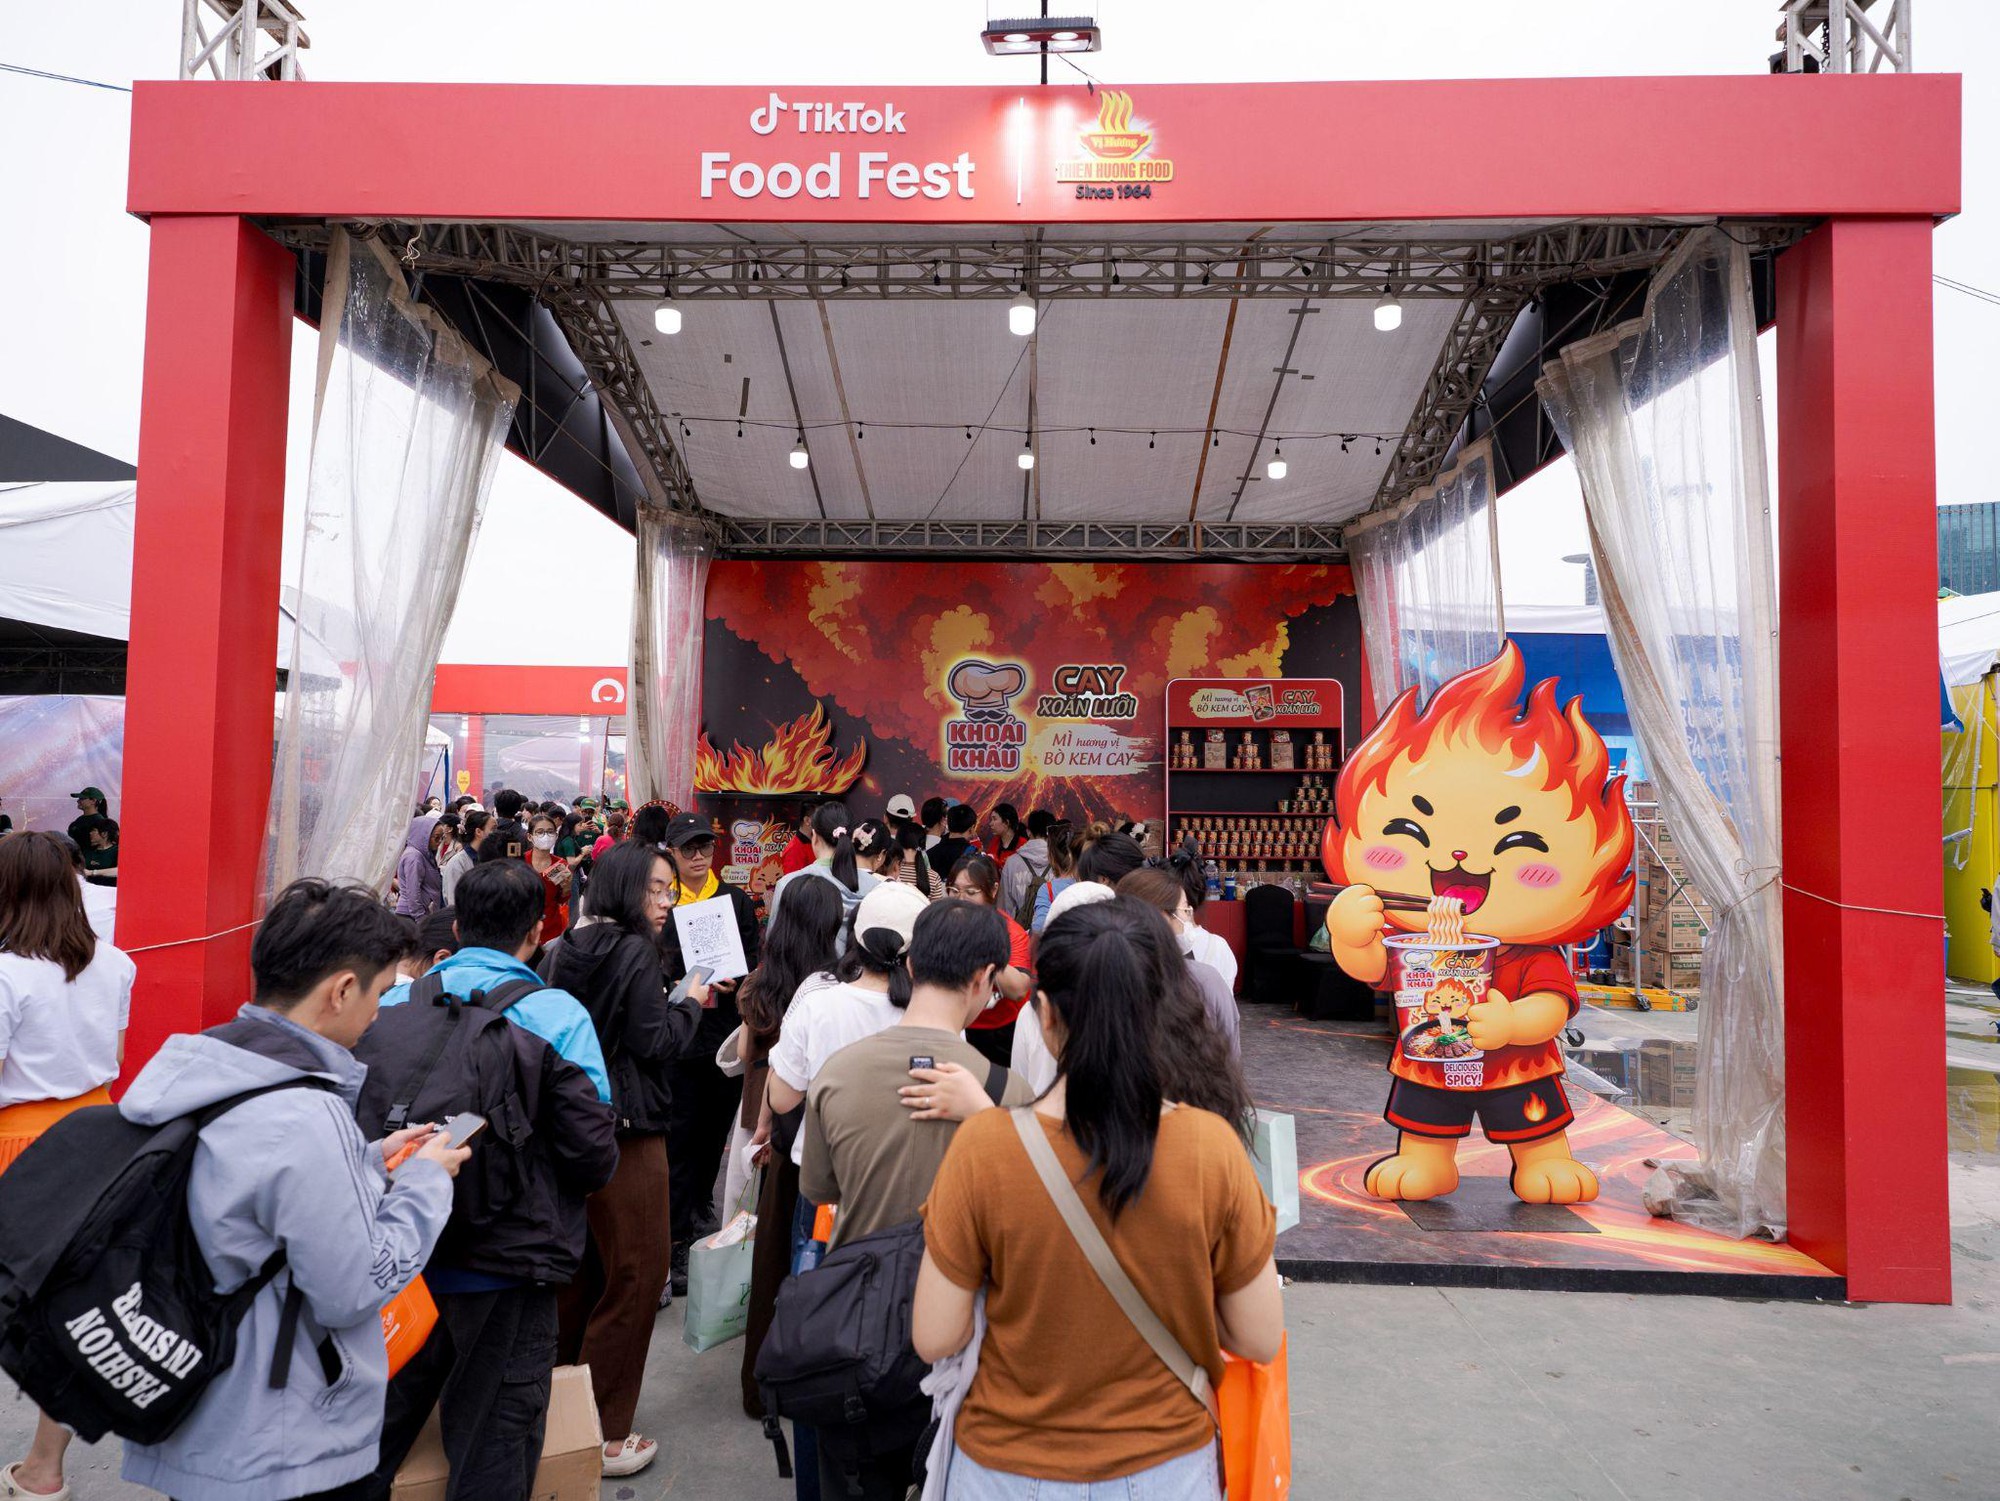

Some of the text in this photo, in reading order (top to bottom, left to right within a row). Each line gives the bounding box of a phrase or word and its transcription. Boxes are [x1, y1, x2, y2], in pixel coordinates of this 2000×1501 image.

[792, 102, 906, 133] TikTok
[700, 151, 976, 199] Food Fest
[1096, 162, 1136, 178] HUONG
[1139, 162, 1170, 178] FOOD
[1075, 184, 1152, 200] Since 1964
[1055, 667, 1126, 695] CAY
[1039, 693, 1136, 716] XOẮN LƯỠI
[1283, 690, 1315, 704] CAY
[1211, 704, 1229, 712] KEM
[1231, 704, 1248, 712] CAY
[949, 718, 1024, 743] KHOÁI
[1052, 731, 1120, 749] MÌ hương vị
[950, 743, 1018, 769] KHẨU
[1044, 748, 1135, 766] BÒ KEM CAY
[1445, 957, 1475, 969] CAY
[1445, 1063, 1483, 1072] DELICIOUSLY
[1446, 1074, 1482, 1085] SPICY!
[64, 1306, 171, 1410] FASHION
